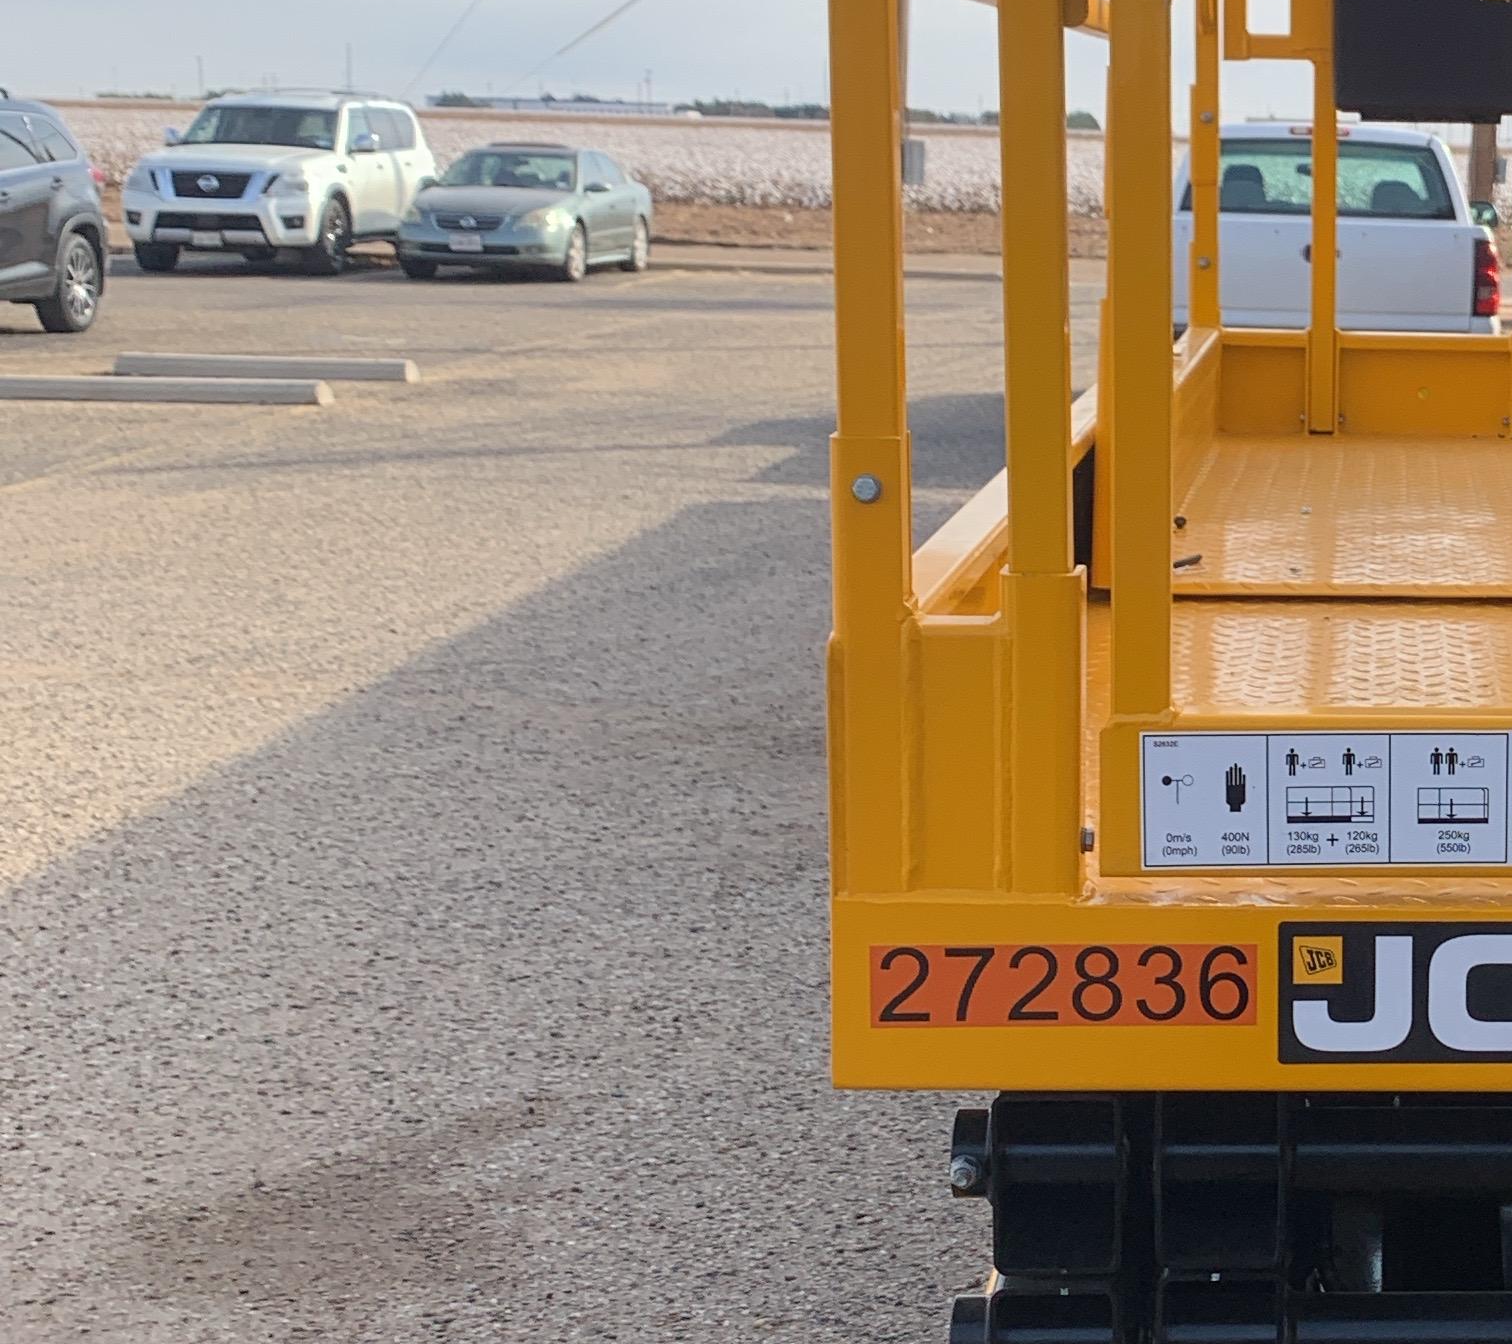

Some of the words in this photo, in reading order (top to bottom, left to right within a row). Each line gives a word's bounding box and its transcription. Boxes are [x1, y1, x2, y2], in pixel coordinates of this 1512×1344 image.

[1166, 832, 1192, 843] 0m/s
[1221, 831, 1250, 842] 400N
[1287, 831, 1319, 843] 130kg
[1346, 830, 1378, 842] 120kg
[1438, 830, 1470, 841] 250kg
[1162, 845, 1198, 857] (0mph)
[1221, 843, 1251, 856] (90lb)
[1306, 949, 1334, 971] JCB
[878, 947, 1250, 1022] 272836
